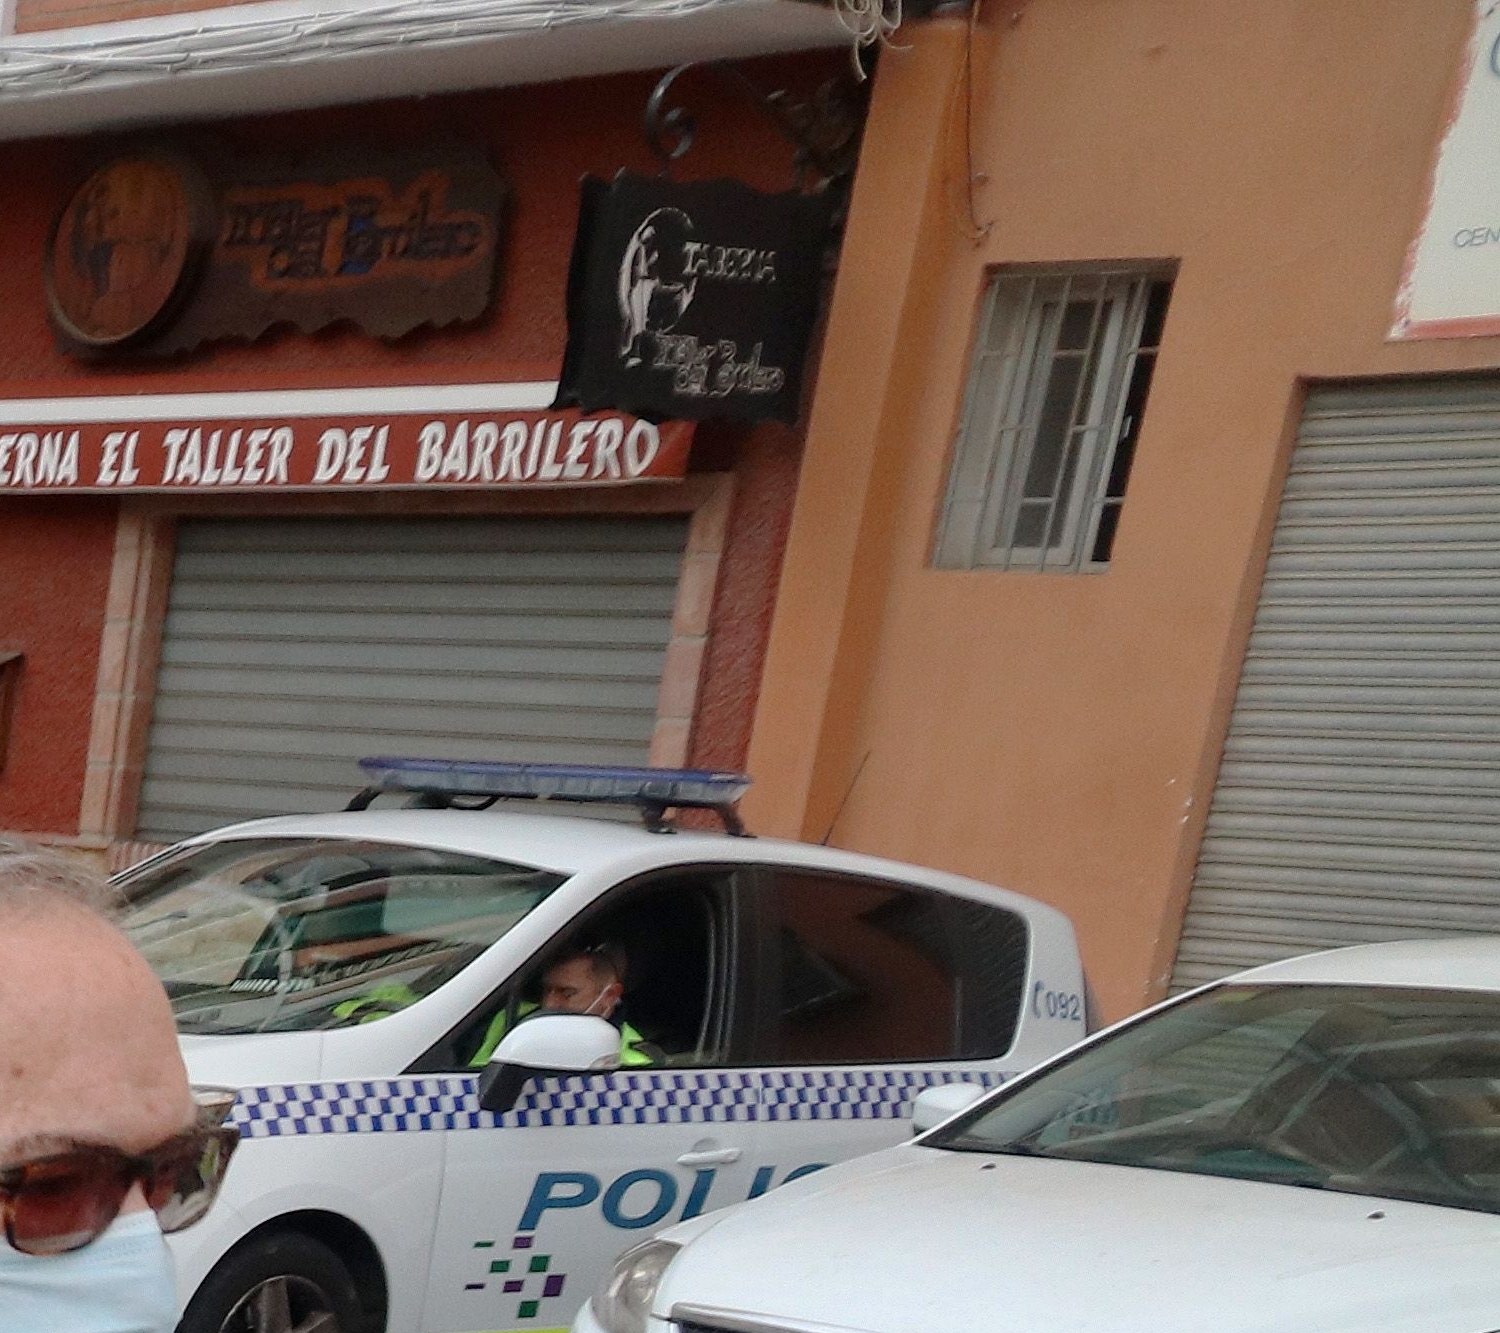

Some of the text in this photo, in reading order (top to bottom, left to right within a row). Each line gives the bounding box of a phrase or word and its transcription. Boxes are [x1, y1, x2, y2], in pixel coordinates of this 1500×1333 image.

[96, 430, 140, 486] EL
[162, 427, 293, 486] TALLER
[312, 424, 390, 483] DEL
[415, 418, 660, 482] BARRILERO
[1046, 991, 1080, 1020] 092
[517, 1162, 834, 1232] POLI
